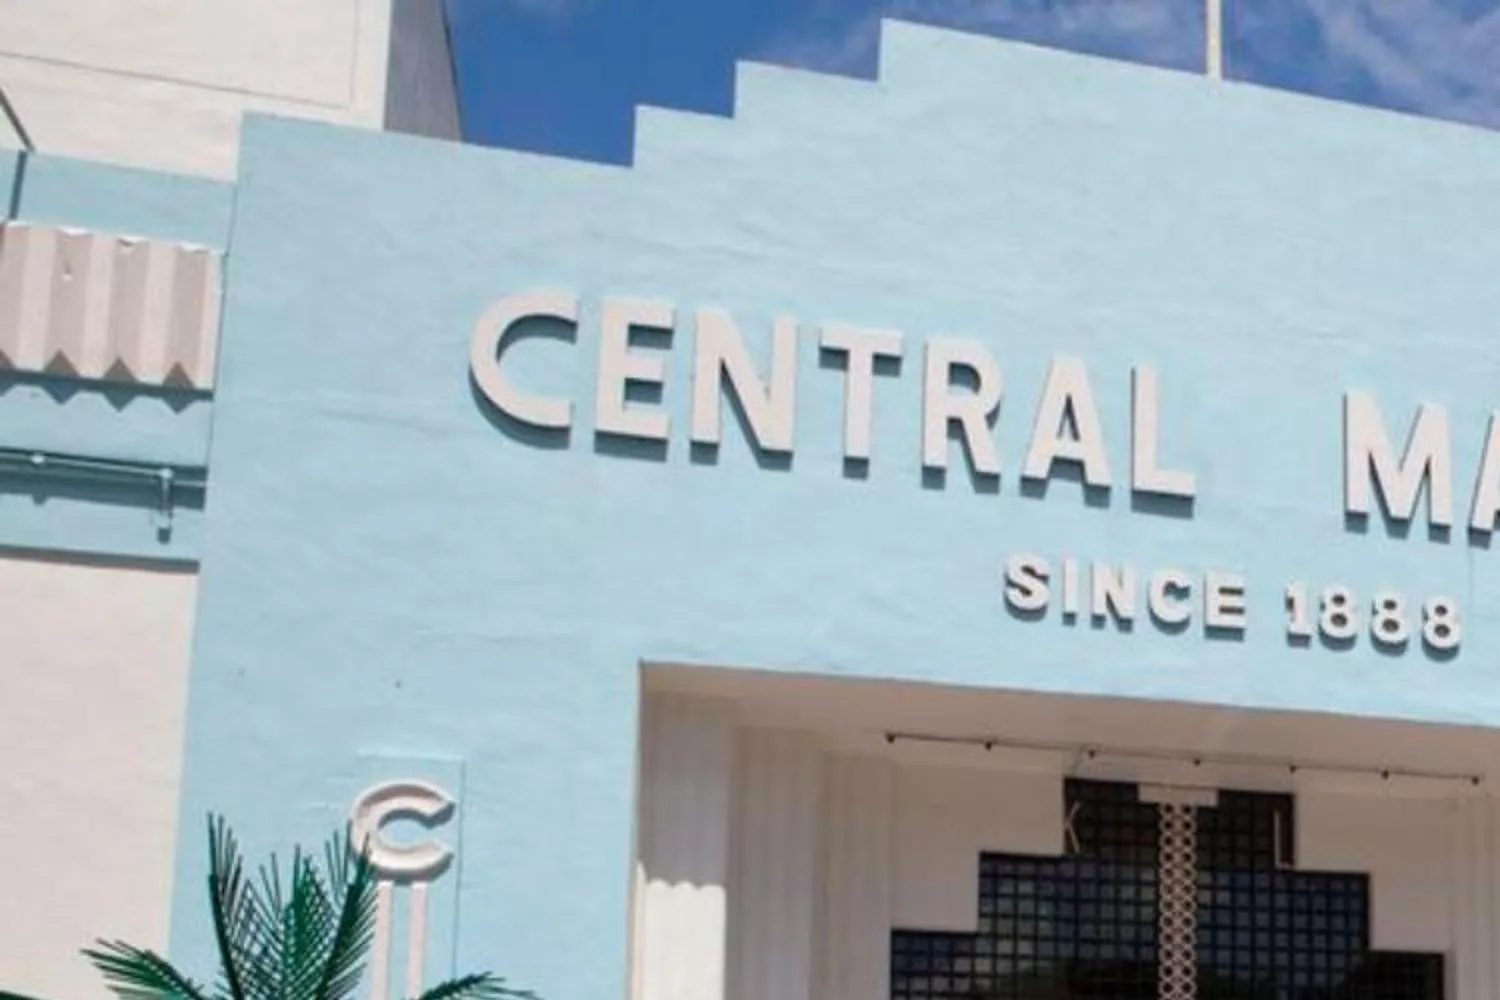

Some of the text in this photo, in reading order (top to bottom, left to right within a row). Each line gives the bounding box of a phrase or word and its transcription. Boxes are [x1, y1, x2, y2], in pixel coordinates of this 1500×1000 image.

[468, 287, 1197, 510] CENTRAL
[1003, 552, 1463, 656] SINCE 1888
